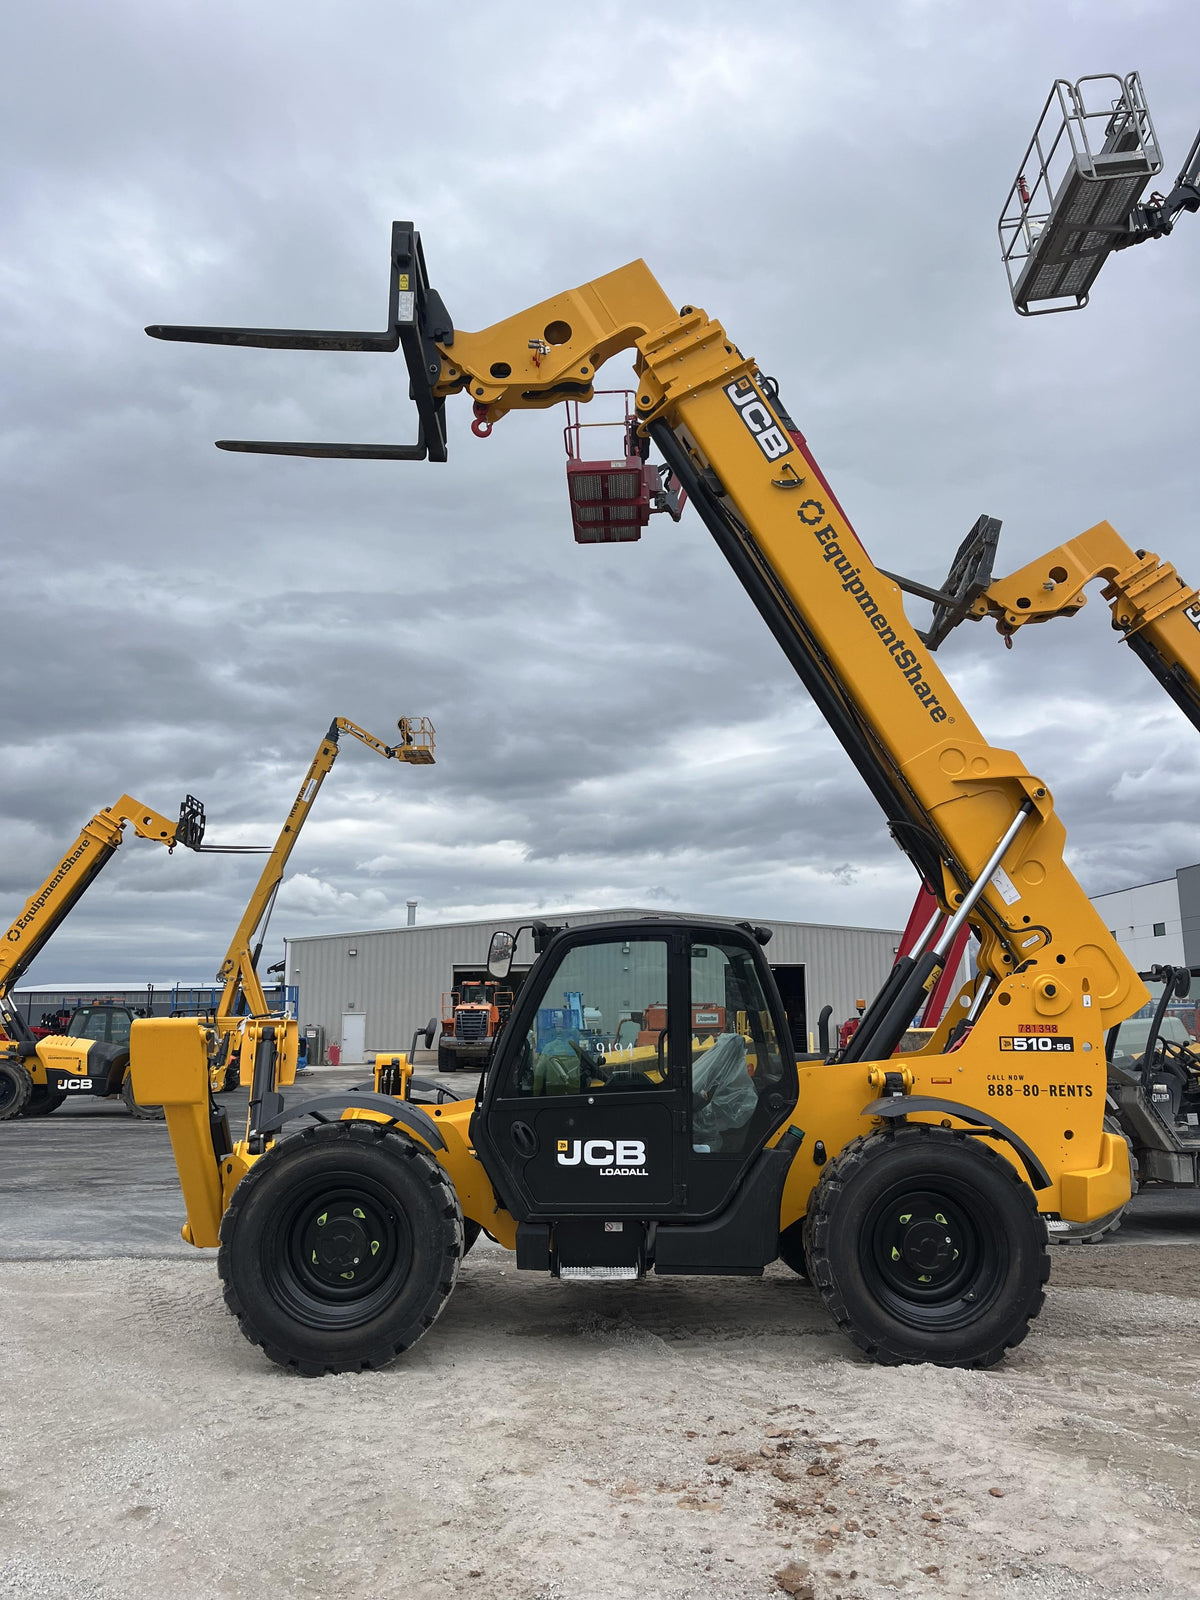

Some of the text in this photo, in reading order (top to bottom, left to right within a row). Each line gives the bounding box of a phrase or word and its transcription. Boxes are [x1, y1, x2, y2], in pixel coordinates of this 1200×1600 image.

[726, 380, 790, 460] JCB
[813, 524, 948, 724] EquipmentShare
[16, 839, 91, 930] EquipmentShare
[1018, 1024, 1058, 1033] 781398
[57, 1079, 93, 1090] JCB
[557, 1140, 647, 1166] JCB
[600, 1168, 649, 1176] LOADALL
